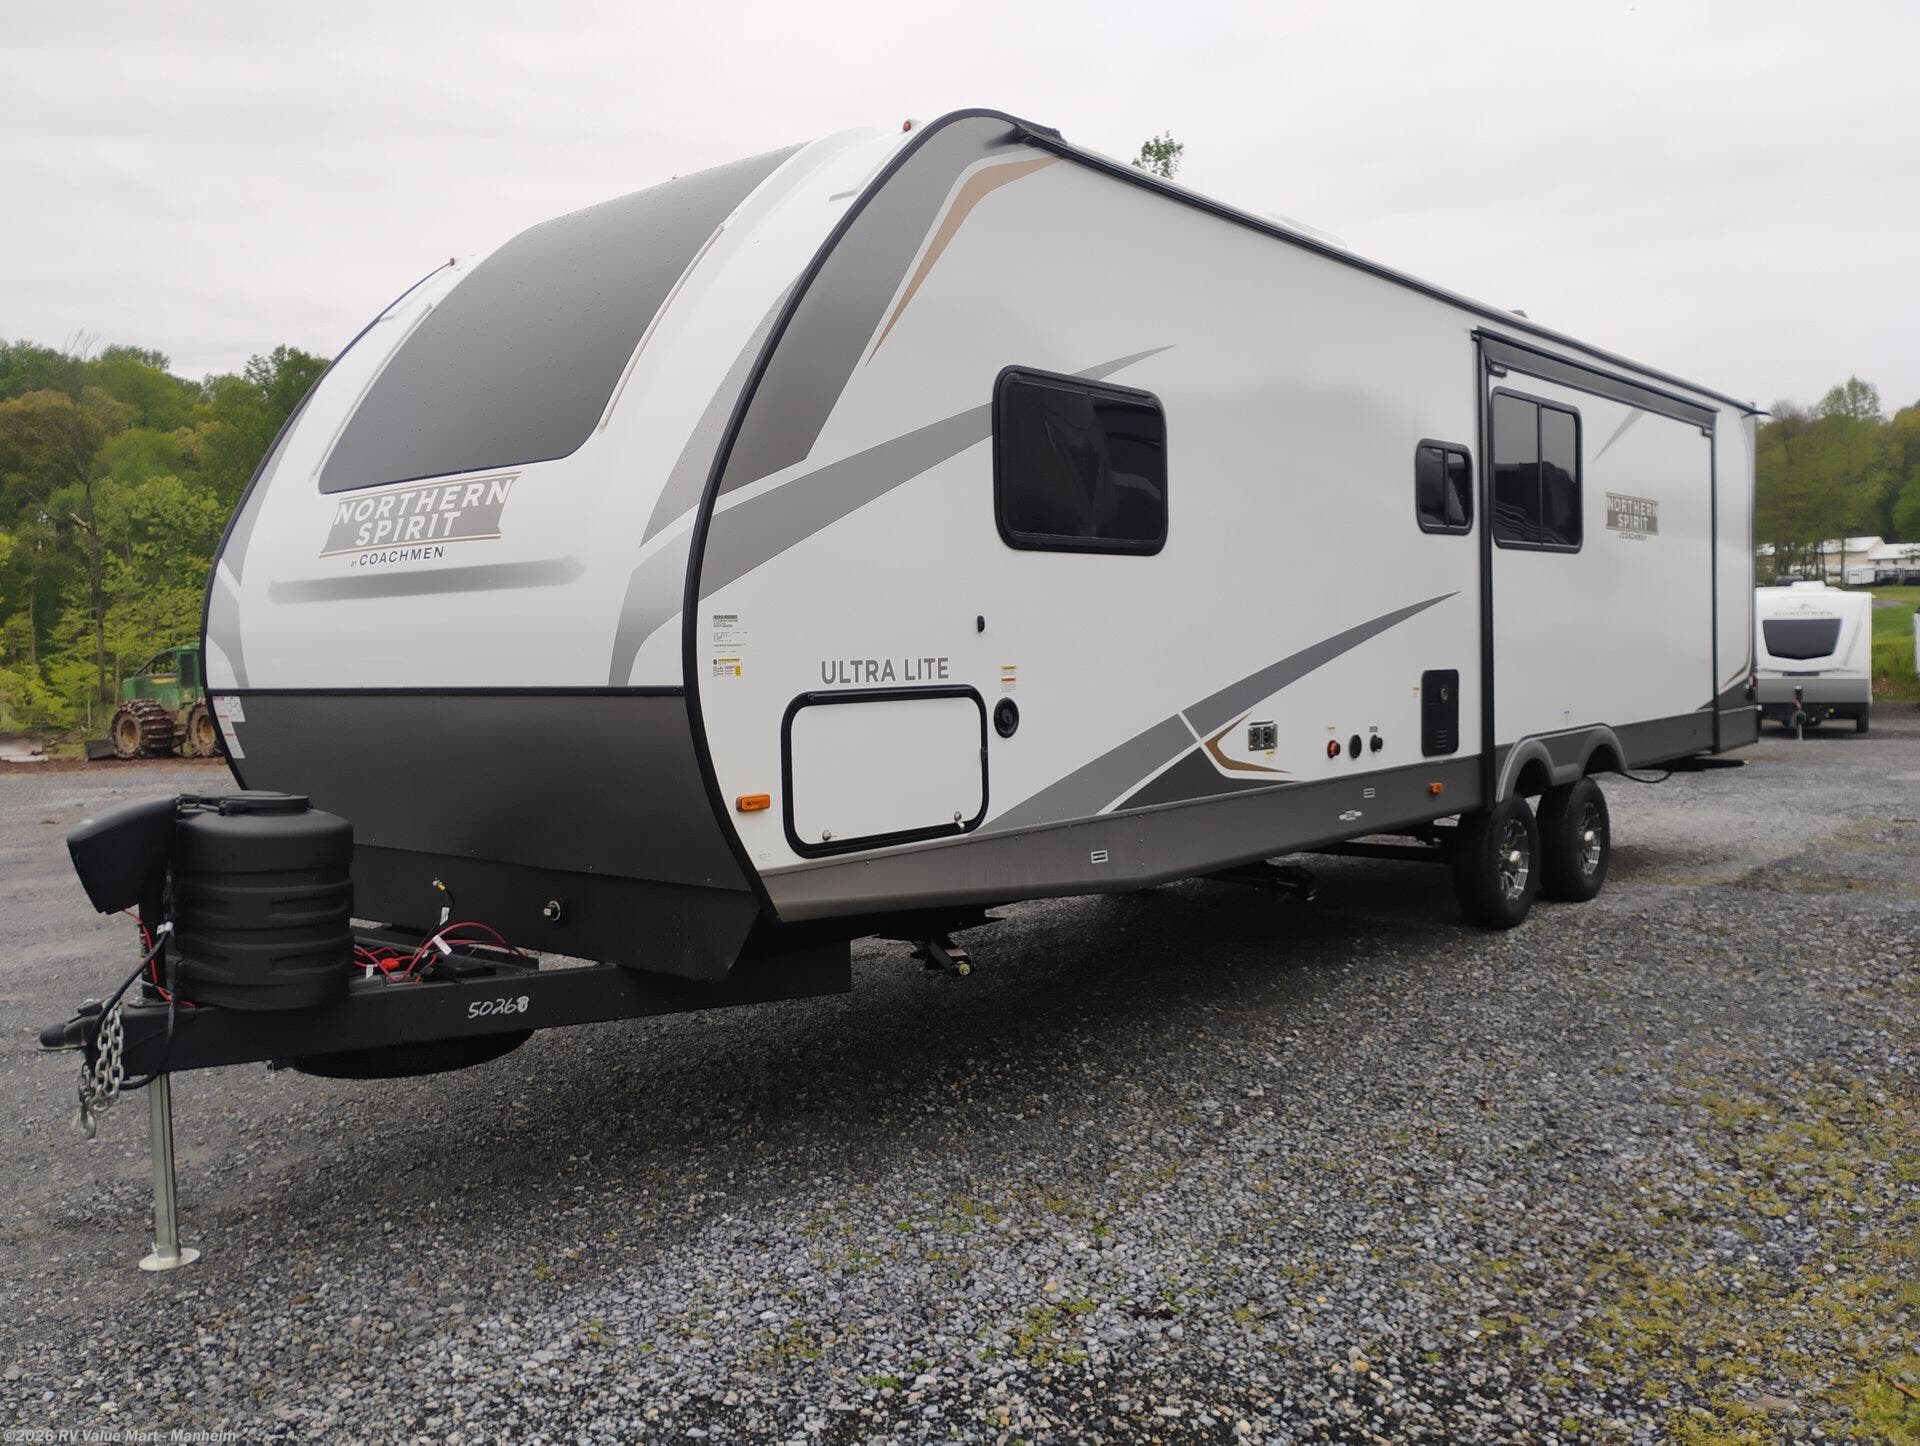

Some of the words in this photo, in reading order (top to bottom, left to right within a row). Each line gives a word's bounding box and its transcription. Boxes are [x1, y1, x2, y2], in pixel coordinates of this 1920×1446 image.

[334, 478, 513, 526] NORTHERN
[1607, 495, 1658, 518] NORTHERN
[355, 510, 462, 547] SPIRIT
[1617, 513, 1649, 531] SPIRIT
[359, 545, 445, 567] COACHMEN
[821, 658, 897, 685] ULTRA
[904, 656, 949, 681] LITE
